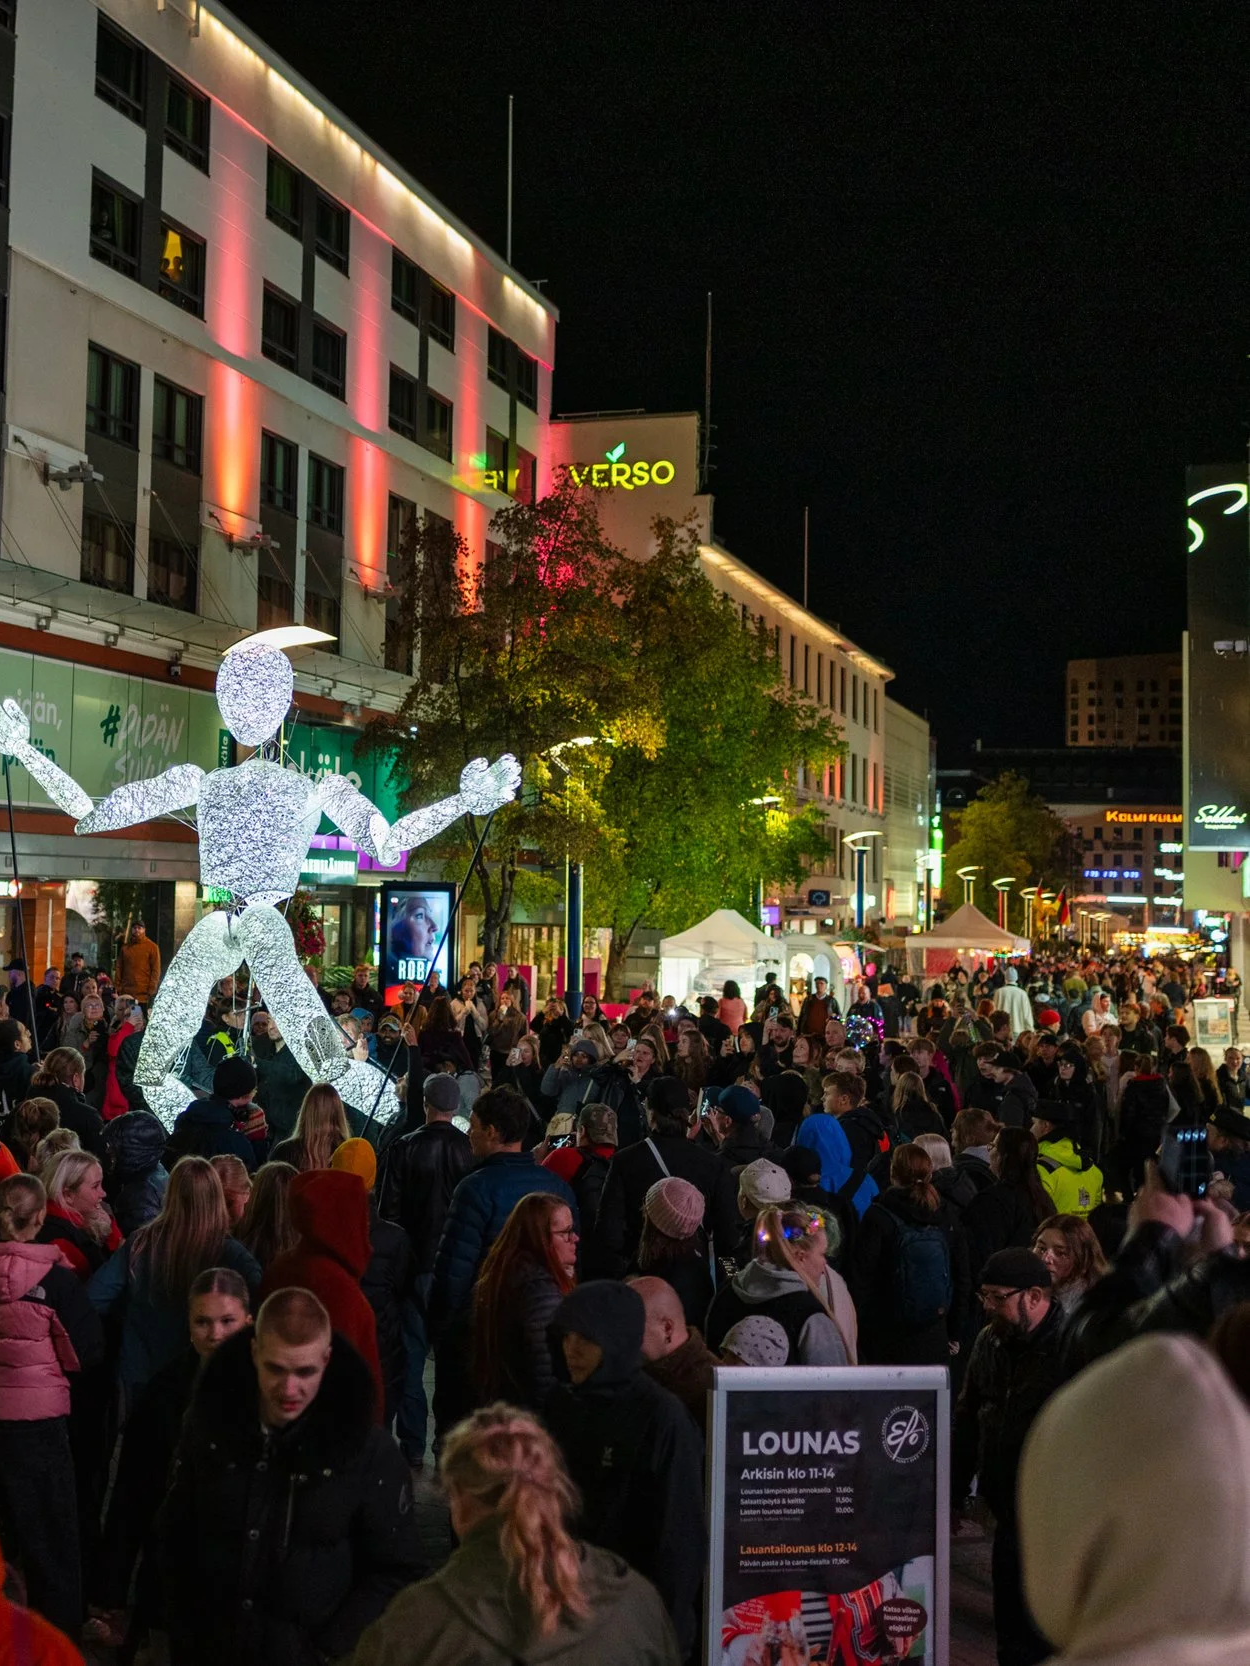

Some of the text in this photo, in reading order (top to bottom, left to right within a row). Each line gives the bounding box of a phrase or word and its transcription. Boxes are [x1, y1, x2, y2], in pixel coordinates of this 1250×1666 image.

[569, 460, 675, 490] VERSO
[742, 1430, 861, 1455] LOUNAS
[740, 1467, 836, 1480] Arkisin klo 11-14
[740, 1508, 761, 1516] Lasten
[740, 1542, 858, 1555] Lauantailounas klo 12-14
[883, 1605, 901, 1614] Katso
